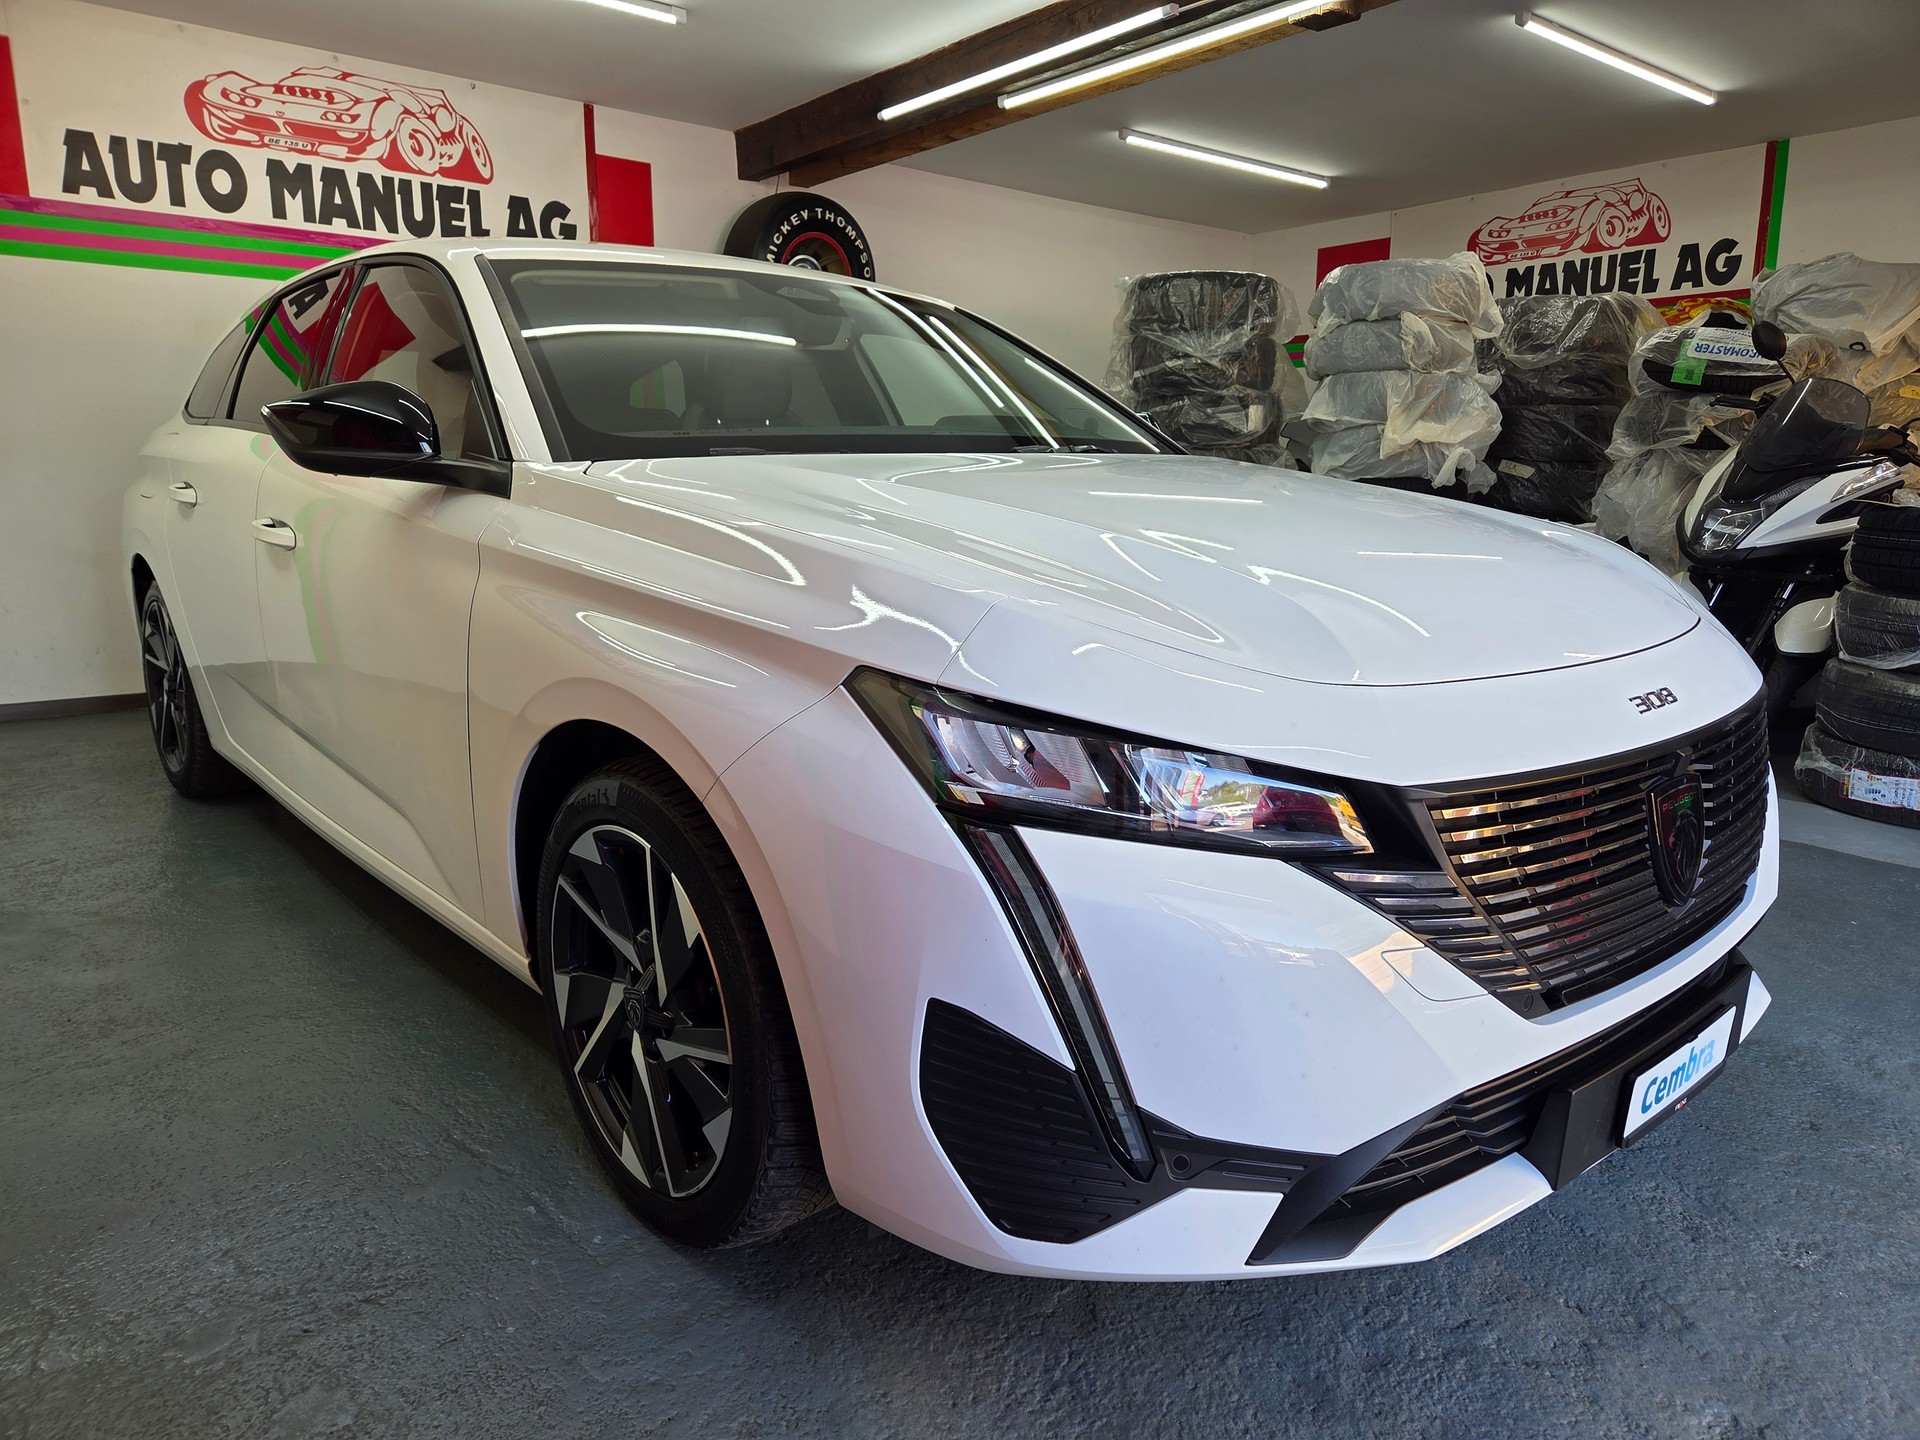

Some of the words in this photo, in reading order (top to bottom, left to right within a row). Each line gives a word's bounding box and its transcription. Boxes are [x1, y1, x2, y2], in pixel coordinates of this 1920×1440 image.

[62, 128, 248, 213] AUTO
[266, 158, 491, 239] MANUEL
[506, 194, 577, 240] AG
[766, 209, 809, 263] MICKEY
[815, 207, 871, 278] THOMPSO
[1505, 248, 1660, 298] MANUEL
[1670, 238, 1743, 291] AG
[1628, 686, 1679, 714] 308
[1662, 791, 1697, 812] PEUGEOT
[1641, 1039, 1716, 1114] Cembra
